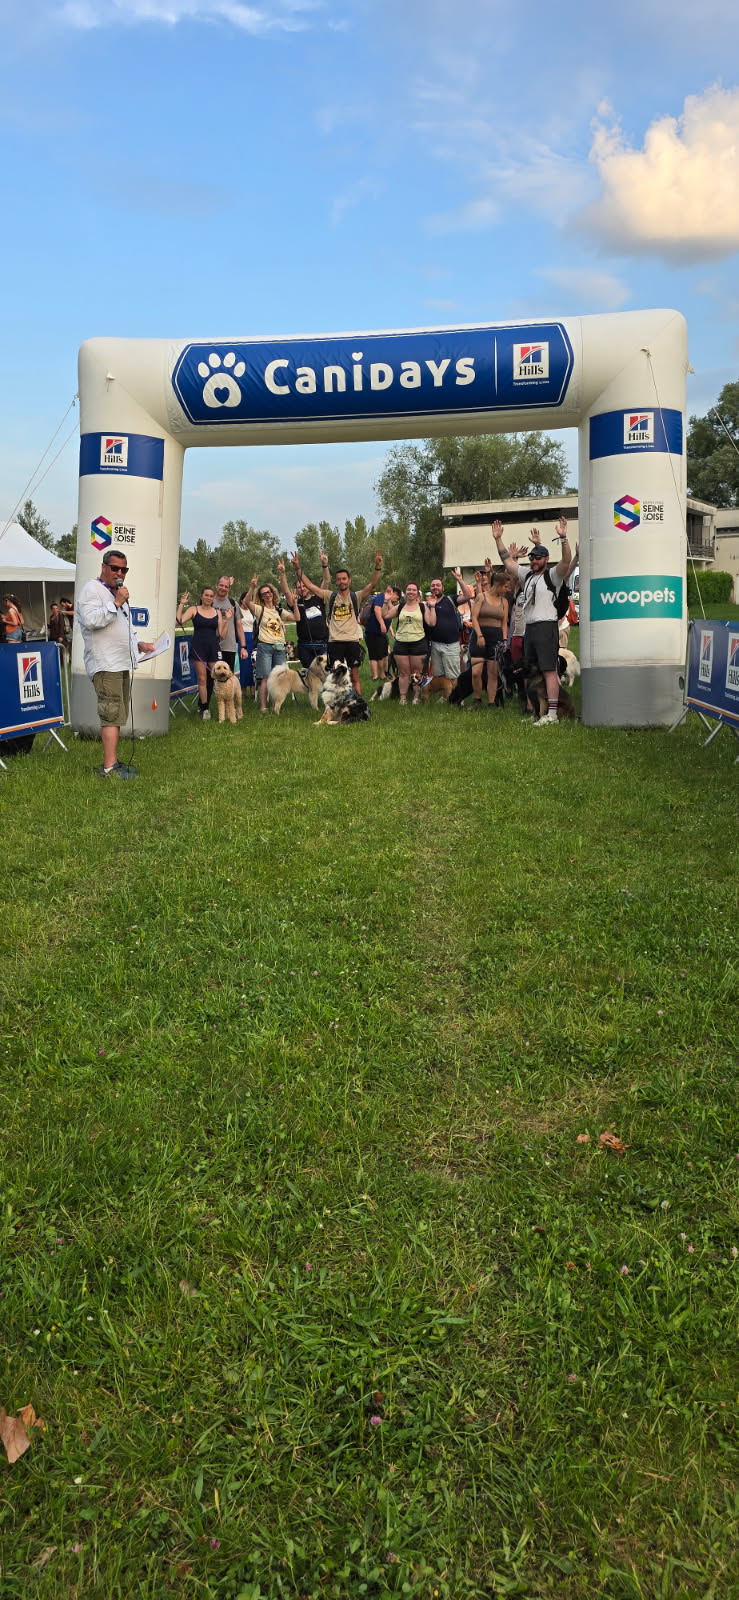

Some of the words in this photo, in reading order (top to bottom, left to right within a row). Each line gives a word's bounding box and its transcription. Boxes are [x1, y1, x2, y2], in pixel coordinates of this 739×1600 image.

[519, 364, 544, 376] Hill's
[628, 432, 650, 441] Hill's
[104, 454, 124, 463] Hill's
[642, 504, 664, 513] SEINE
[114, 526, 136, 536] SEINE
[600, 587, 676, 607] woopets
[23, 683, 41, 699] Hill's
